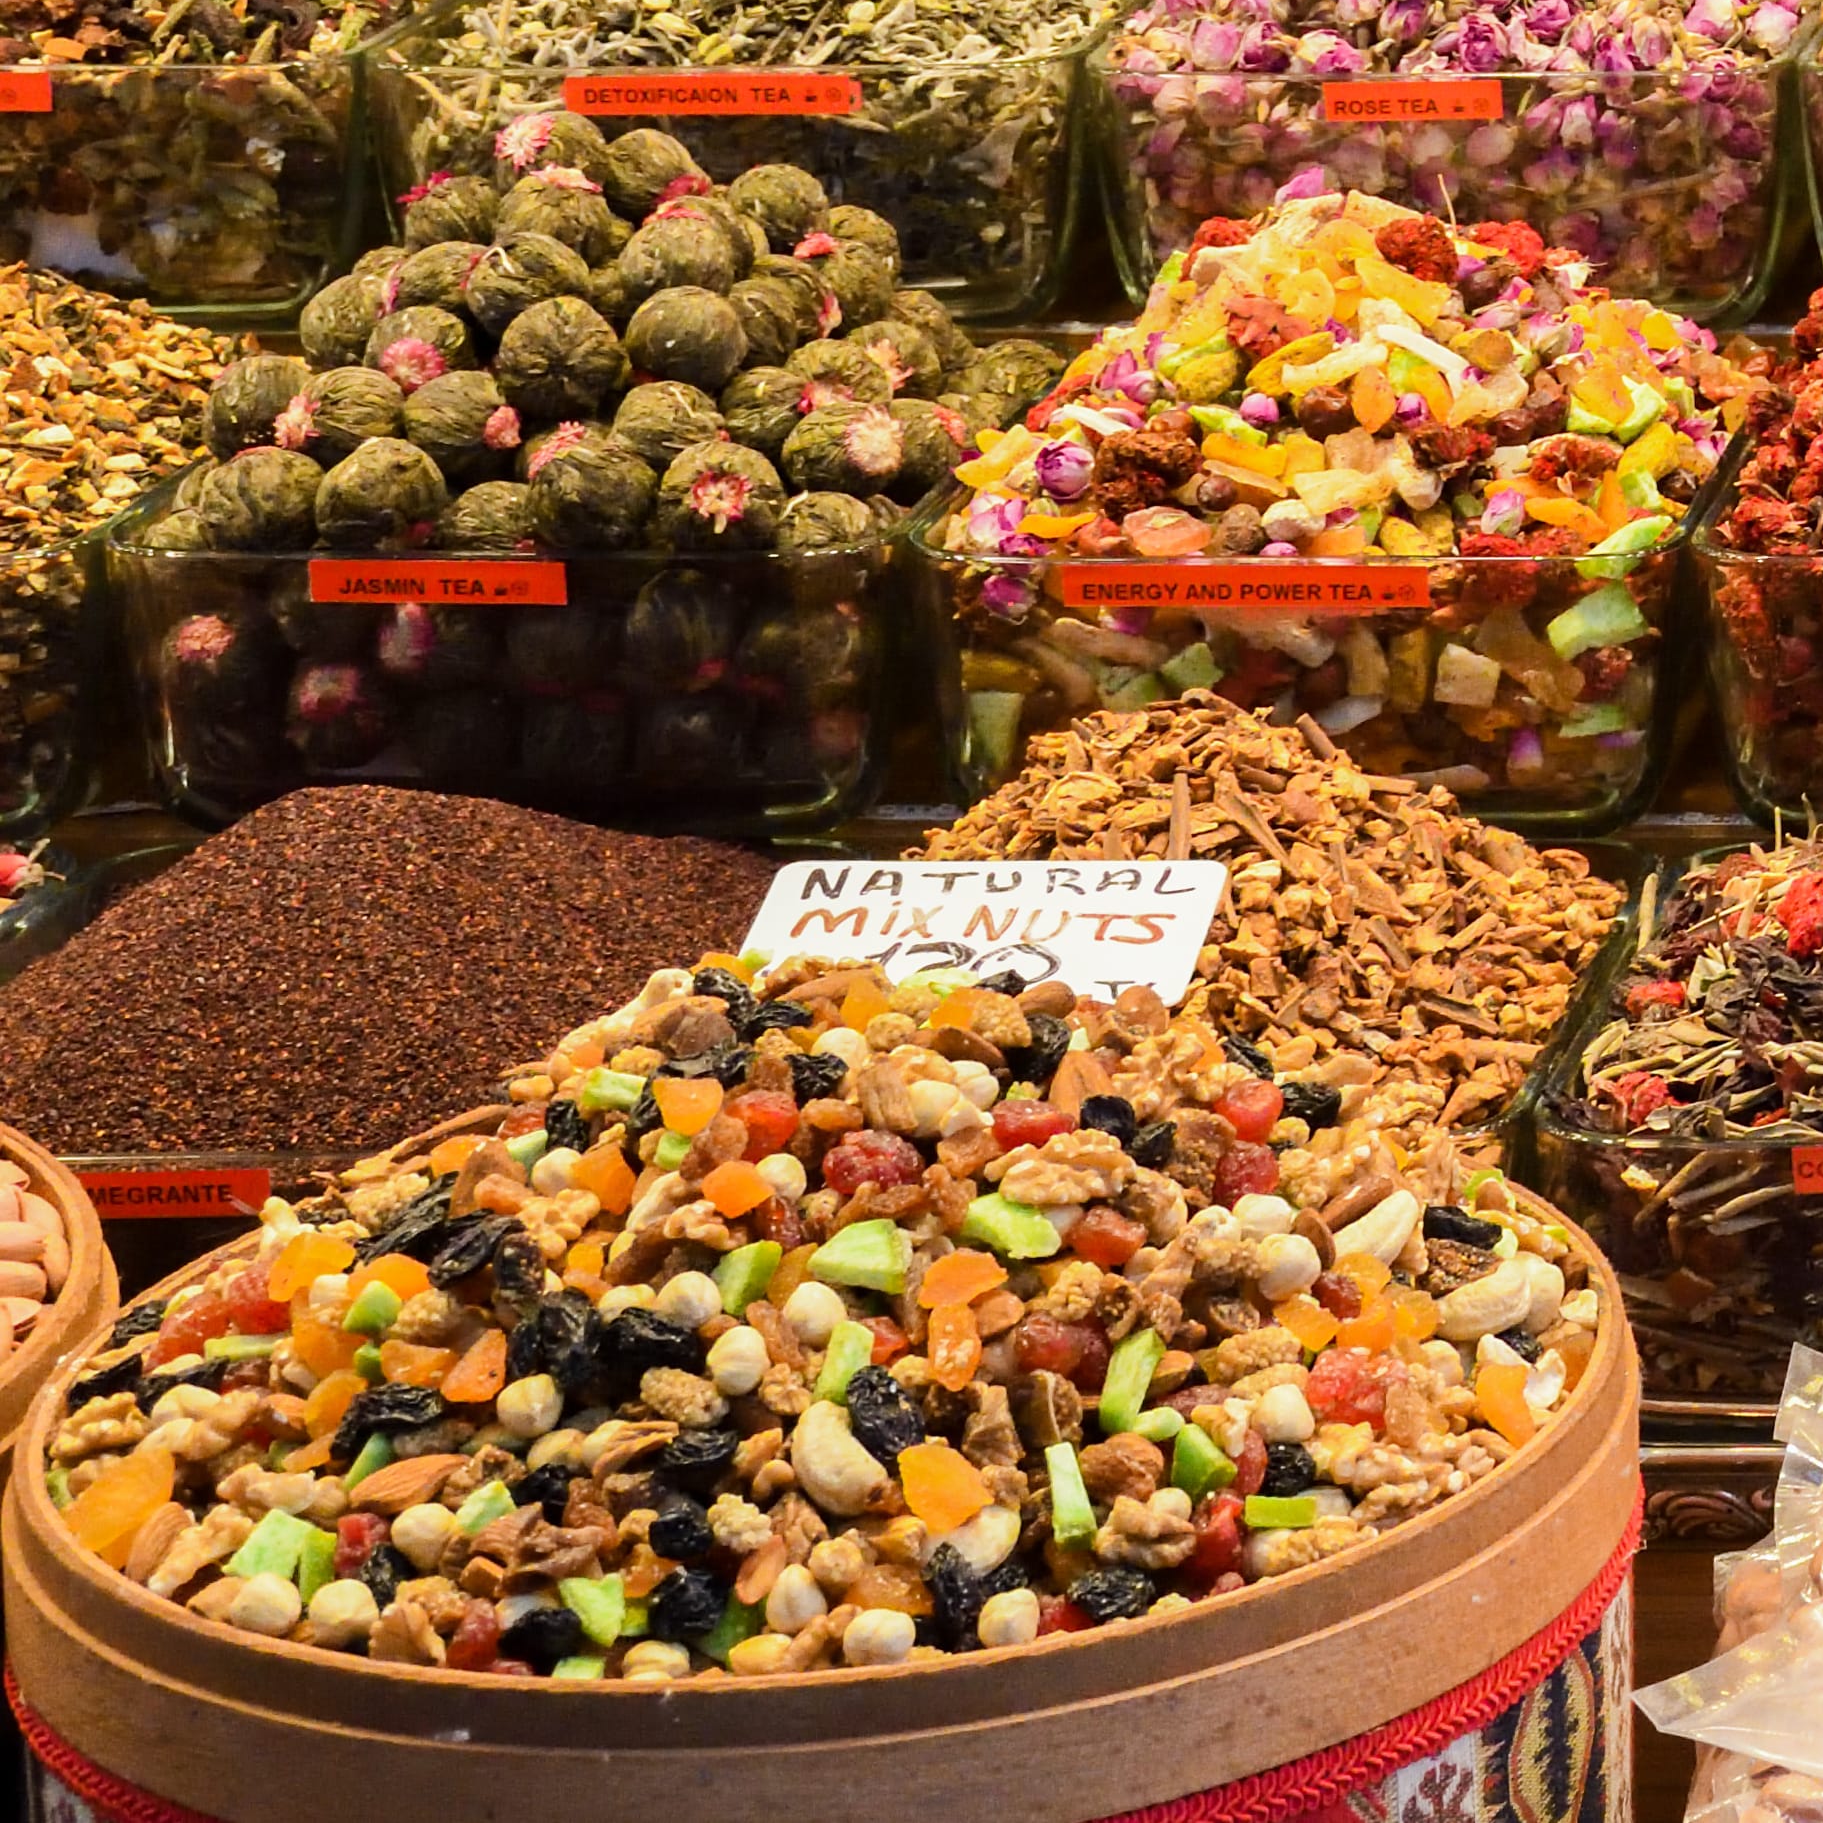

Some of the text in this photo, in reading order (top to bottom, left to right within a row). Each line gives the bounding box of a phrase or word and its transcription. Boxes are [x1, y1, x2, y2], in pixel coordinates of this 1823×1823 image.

[584, 87, 791, 104] DETOXIFICAION TEA
[1334, 99, 1438, 116] ROSE TEA
[339, 578, 485, 595] JASMIN TEA
[1082, 583, 1373, 601] ENERGY AND POWER TEA
[801, 866, 1196, 900] NATURAL
[963, 905, 1177, 945] NUTS
[86, 1183, 233, 1205] MEGRANTE
